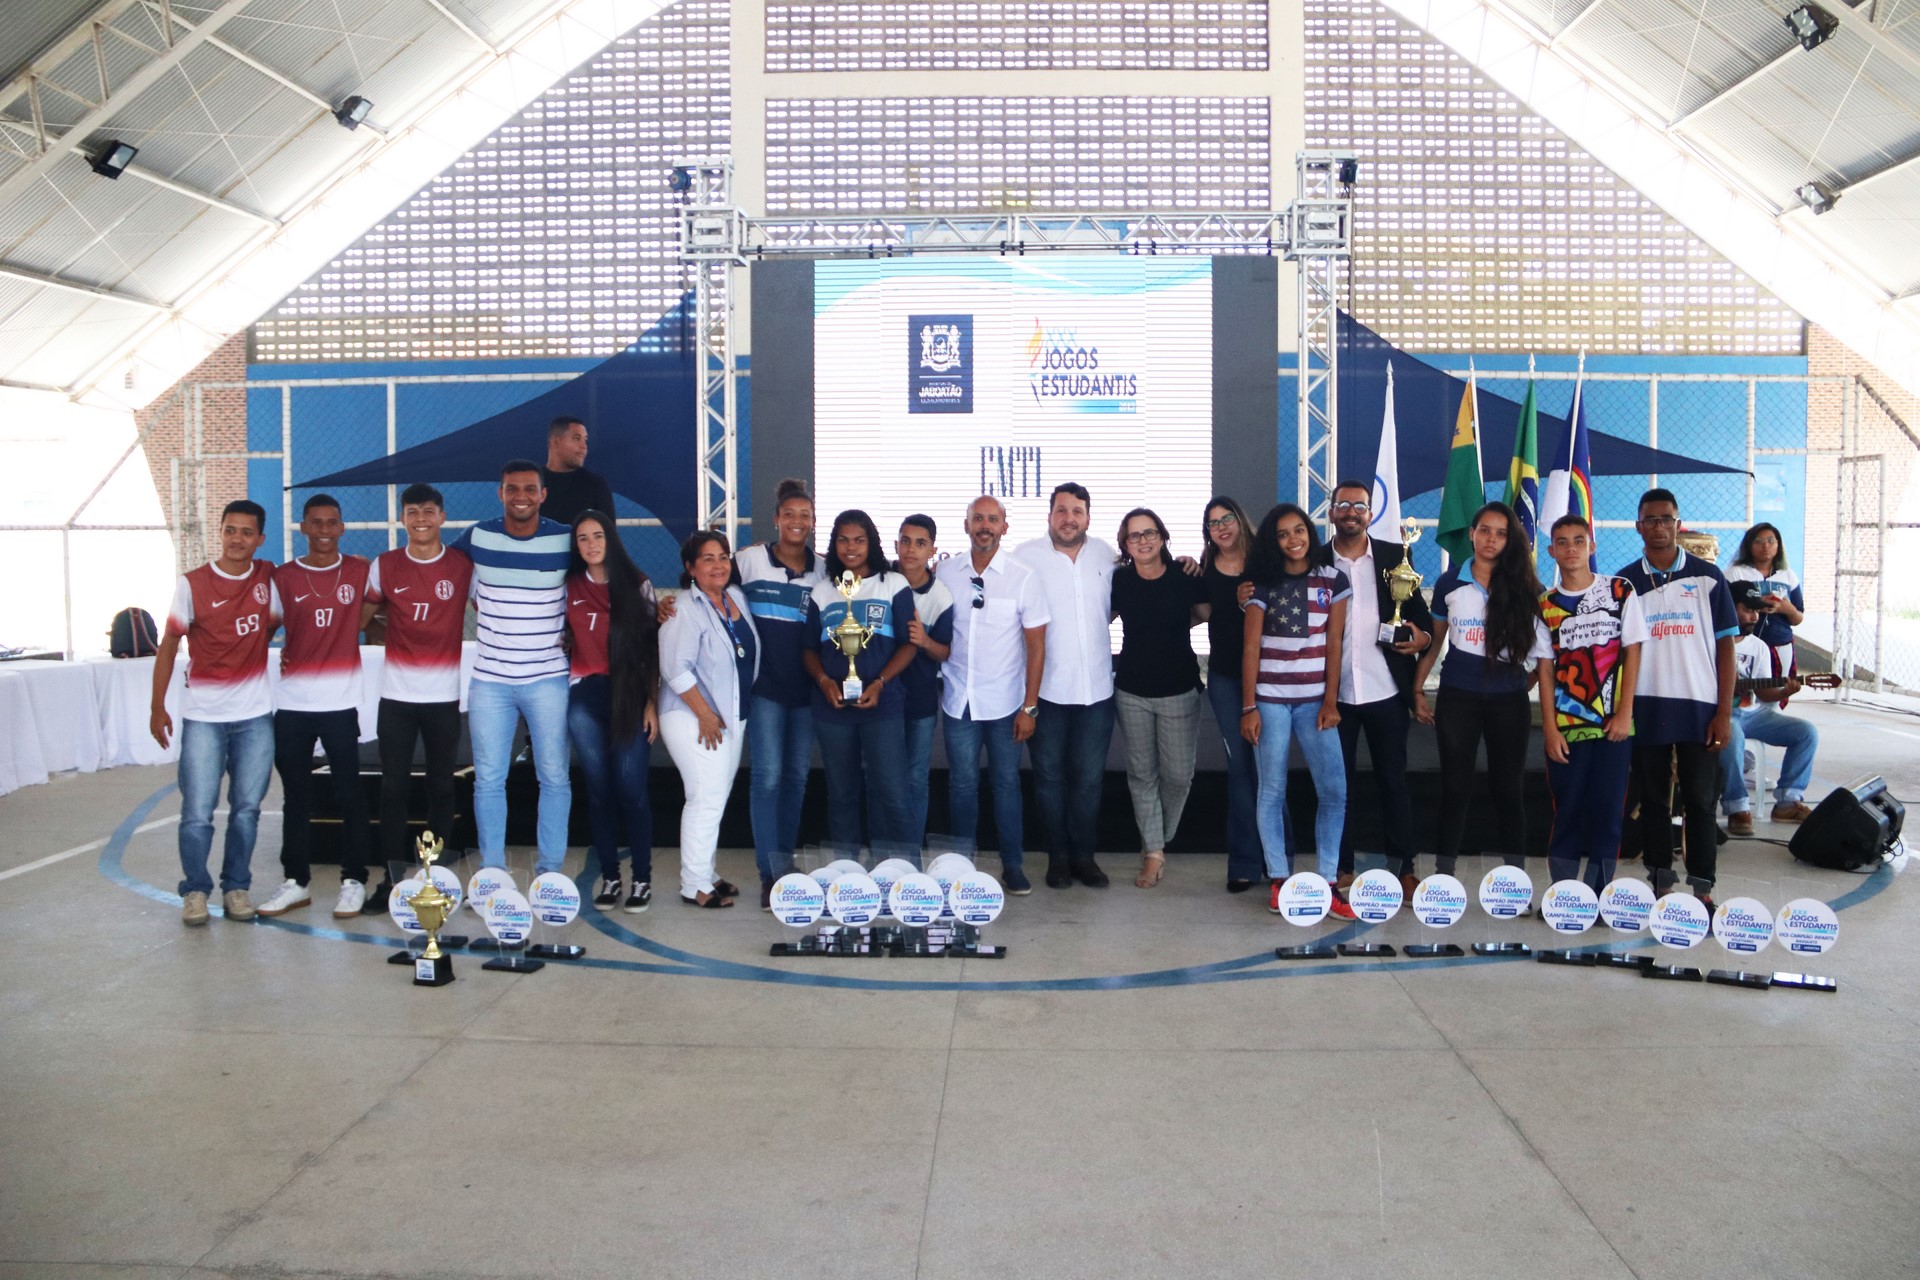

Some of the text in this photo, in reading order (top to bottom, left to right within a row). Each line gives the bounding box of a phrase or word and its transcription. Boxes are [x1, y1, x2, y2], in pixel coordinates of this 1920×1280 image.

[1045, 326, 1077, 347] XXX
[1042, 347, 1098, 370] JOGOS
[1042, 374, 1137, 396] ESTUDANTIS
[412, 602, 430, 621] 77
[1646, 610, 1694, 623] conhecimento
[315, 608, 334, 628] 87
[587, 613, 598, 631] 7
[235, 613, 260, 636] 69
[1574, 621, 1616, 631] Pernambuco
[1651, 621, 1695, 640] diferença
[1465, 627, 1487, 646] dife
[540, 893, 580, 902] ESTUDANTIS
[782, 894, 824, 902] ESTUDANTIS
[839, 893, 880, 902] ESTUDANTIS
[1361, 890, 1402, 898] ESTUDANTIS
[1612, 892, 1639, 901] JOGOS
[1555, 901, 1598, 910] ESTUDANTIS
[1612, 899, 1654, 910] ESTUDANTI
[494, 910, 531, 918] ESTUDANTIS
[1602, 909, 1650, 920] CAMPEÃO INFANTI
[1664, 907, 1691, 916] JOGOS
[1663, 914, 1708, 927] ESTUDANTIS
[1727, 913, 1754, 922] JOGOS
[1790, 914, 1819, 922] JOGOS
[1726, 920, 1773, 930] ESTUDANTIS
[1790, 921, 1838, 931] ESTUDANTIS
[1724, 930, 1747, 939] LUGAR
[1747, 933, 1769, 941] MIRIM
